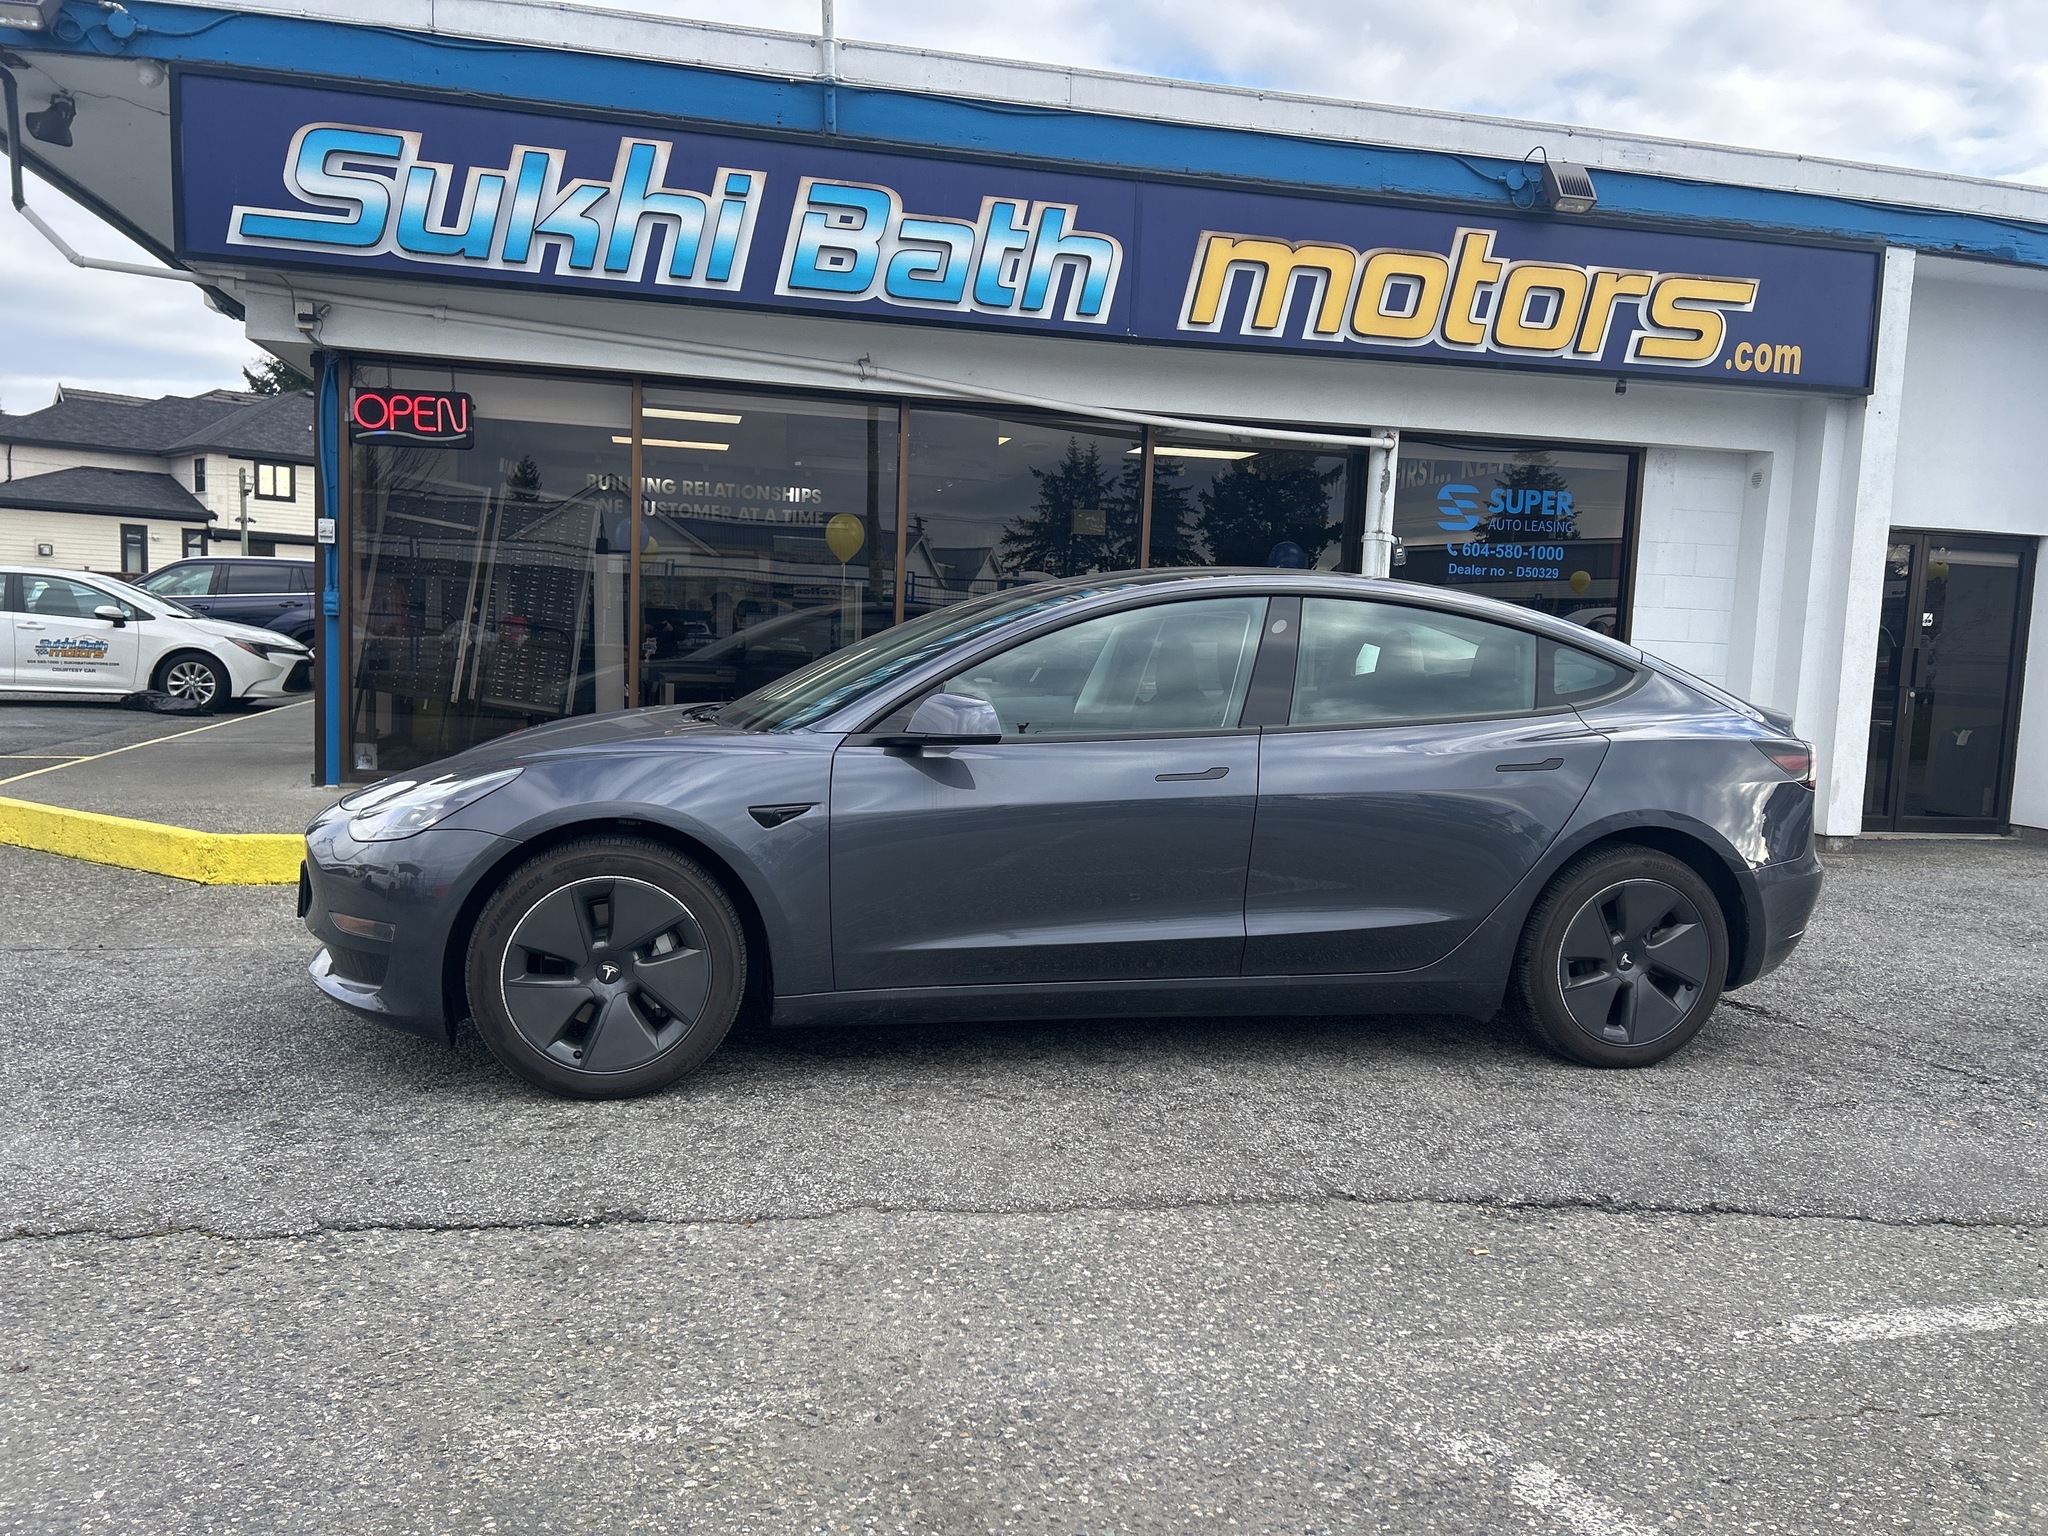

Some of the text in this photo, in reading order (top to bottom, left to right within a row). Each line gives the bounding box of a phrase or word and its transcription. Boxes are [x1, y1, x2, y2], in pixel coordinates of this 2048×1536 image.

[226, 122, 1123, 324] Sukhi Bath
[1177, 226, 1802, 376] motors .com
[353, 391, 469, 434] OPEN
[586, 473, 823, 505] BUILING RELATIONSHIPS
[1488, 488, 1574, 517] SUPER
[641, 500, 732, 521] USTOMER
[738, 506, 760, 522] AT
[765, 508, 777, 523] A
[782, 508, 824, 526] TIME
[1488, 518, 1574, 534] AUTO LEASING
[1461, 542, 1565, 561] 604-580-1000
[1448, 563, 1488, 577] Dealer
[1490, 567, 1505, 577] no
[1516, 565, 1560, 580] D50329
[48, 648, 105, 658] motors
